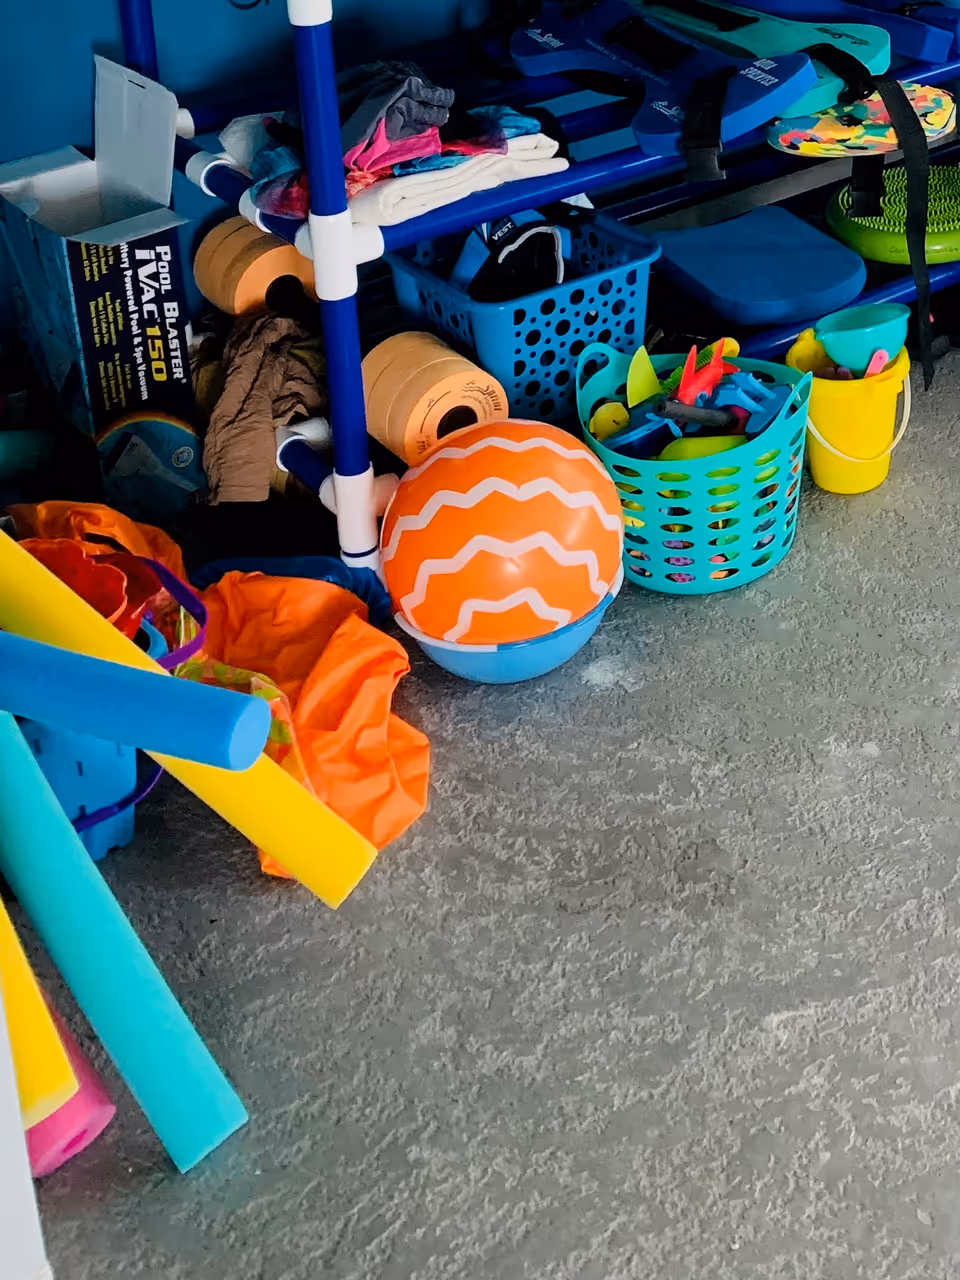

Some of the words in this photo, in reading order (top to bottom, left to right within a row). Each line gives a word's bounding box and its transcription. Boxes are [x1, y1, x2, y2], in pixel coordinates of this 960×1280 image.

[491, 221, 513, 241] VEST
[123, 269, 139, 312] Powered
[129, 312, 142, 335] Pool
[133, 336, 143, 345] &
[132, 346, 144, 364] Spa
[146, 325, 168, 382] 150
[137, 363, 149, 401] Vacuum
